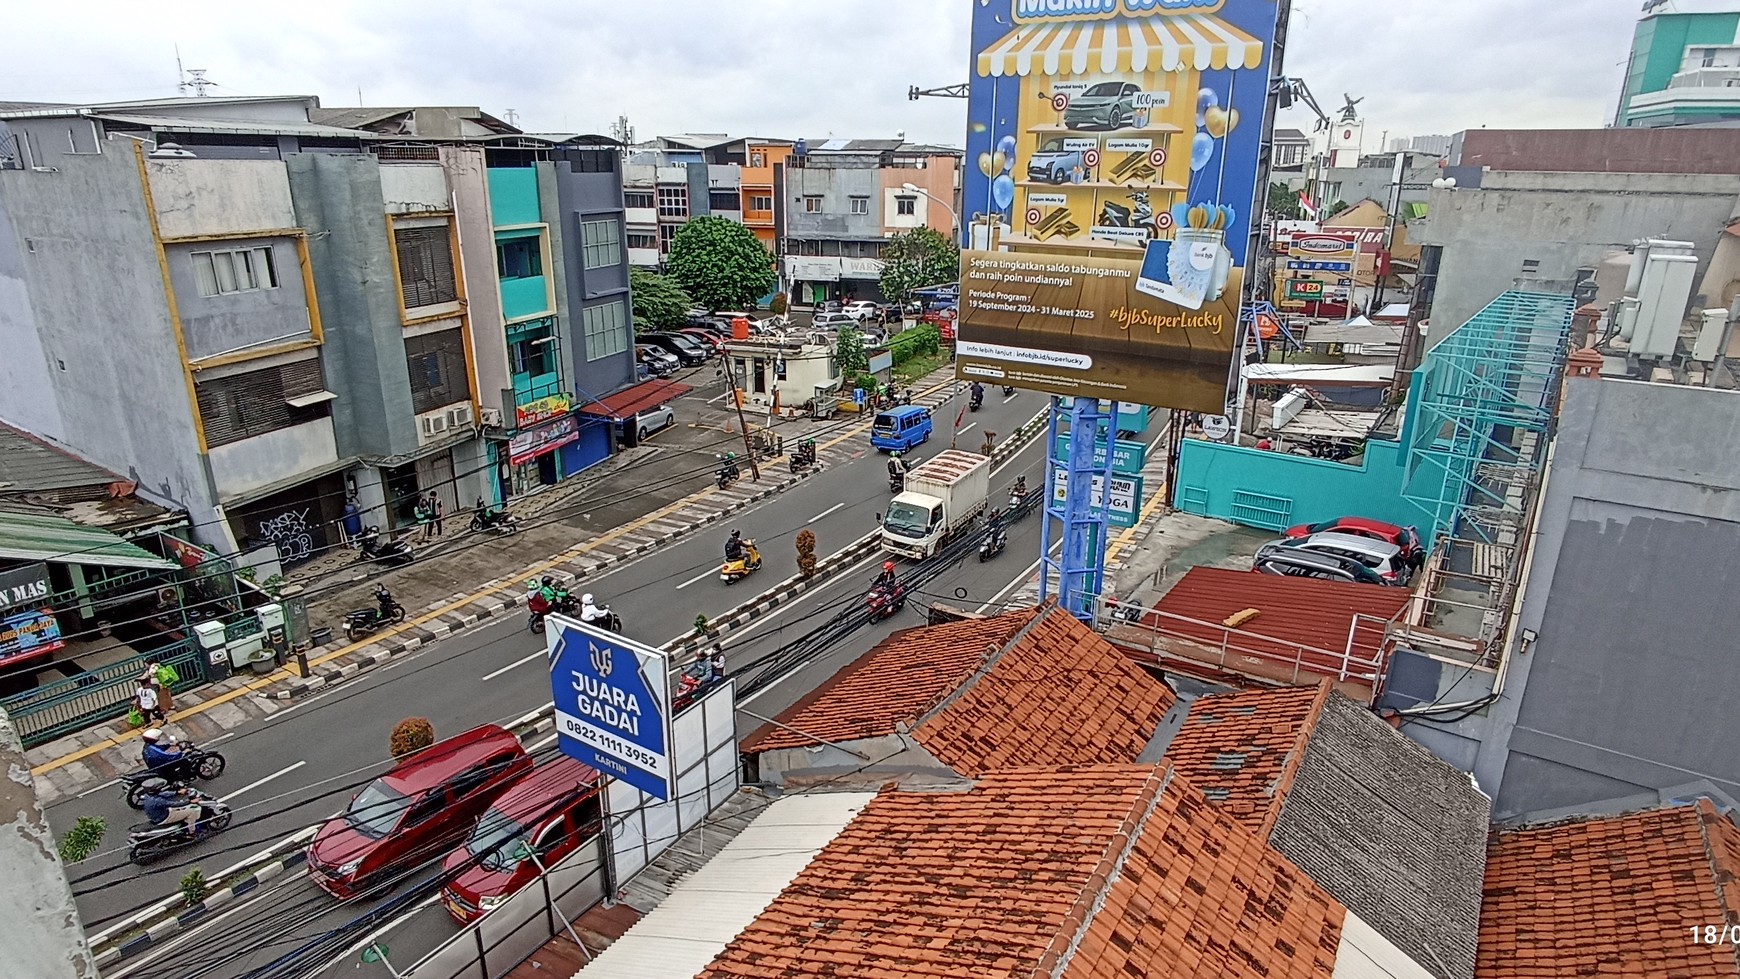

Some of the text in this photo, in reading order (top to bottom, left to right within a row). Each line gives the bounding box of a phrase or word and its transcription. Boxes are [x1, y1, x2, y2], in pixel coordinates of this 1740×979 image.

[1136, 94, 1151, 104] 100
[1304, 241, 1343, 249] Indomaret
[970, 258, 1131, 278] Segera tingkatkan saldo tabunganmu
[970, 270, 1072, 288] dan raih poin undiannya!
[969, 290, 995, 300] Periode
[996, 291, 1026, 303] Program
[969, 300, 977, 308] 19
[978, 301, 1017, 312] September
[1017, 304, 1036, 313] 2024
[1041, 305, 1050, 314] 31
[1052, 306, 1074, 317] Maret
[1075, 309, 1094, 319] 2025
[1109, 306, 1223, 334] #bjbSuperLucky
[994, 348, 1012, 357] lanjut
[12, 580, 47, 602] MAS
[572, 670, 642, 716] JUARA
[578, 694, 639, 736] GADAI
[566, 719, 657, 769] 0822 1111 3952
[594, 753, 627, 775] KARTINI
